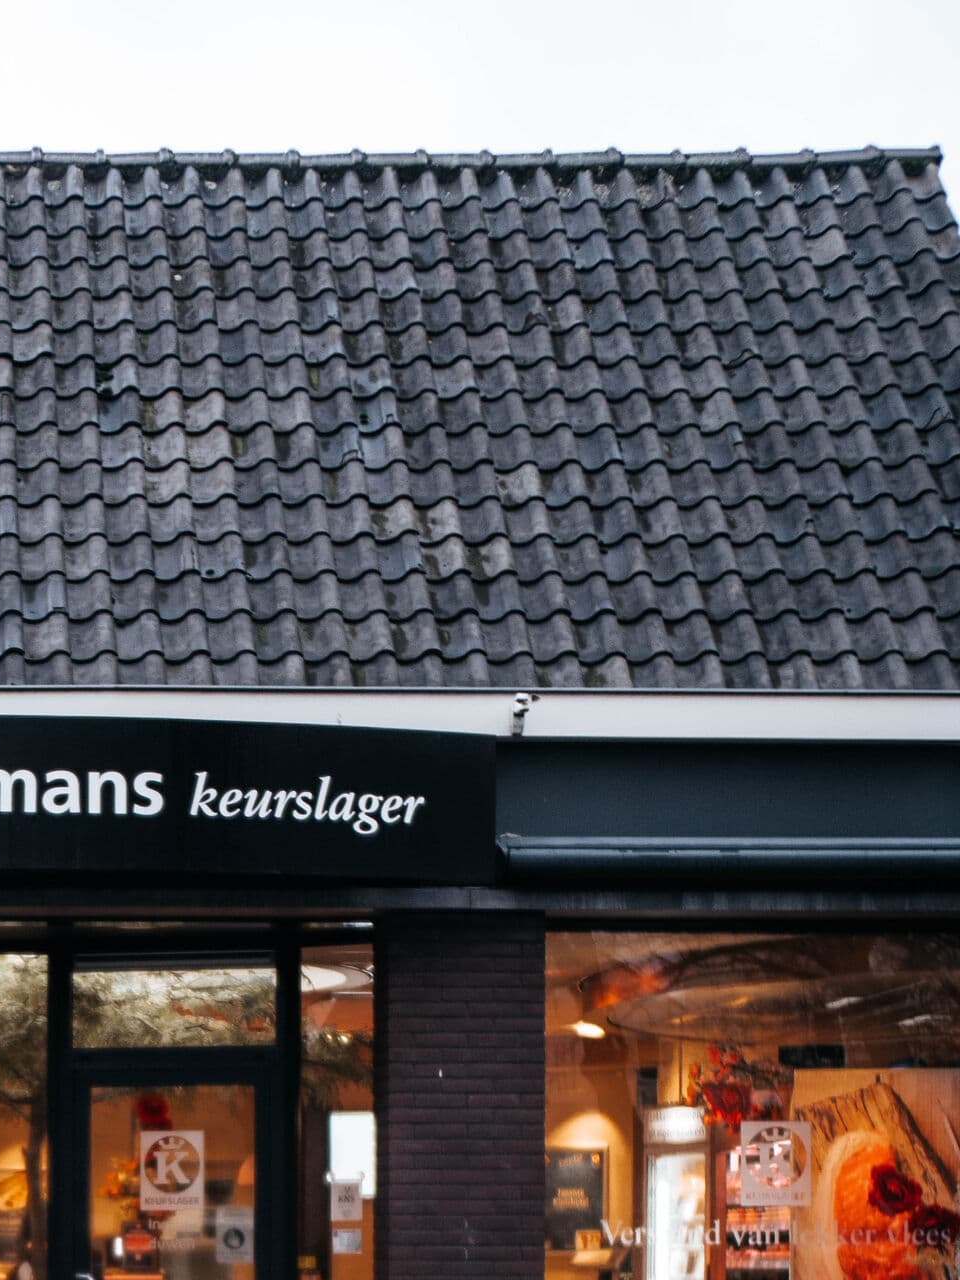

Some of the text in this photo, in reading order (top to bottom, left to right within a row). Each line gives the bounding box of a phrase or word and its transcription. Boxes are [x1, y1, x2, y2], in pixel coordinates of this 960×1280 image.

[189, 771, 425, 834] keurslager
[153, 1151, 190, 1185] K
[732, 1226, 780, 1246] van
[886, 1218, 951, 1245] vlees
